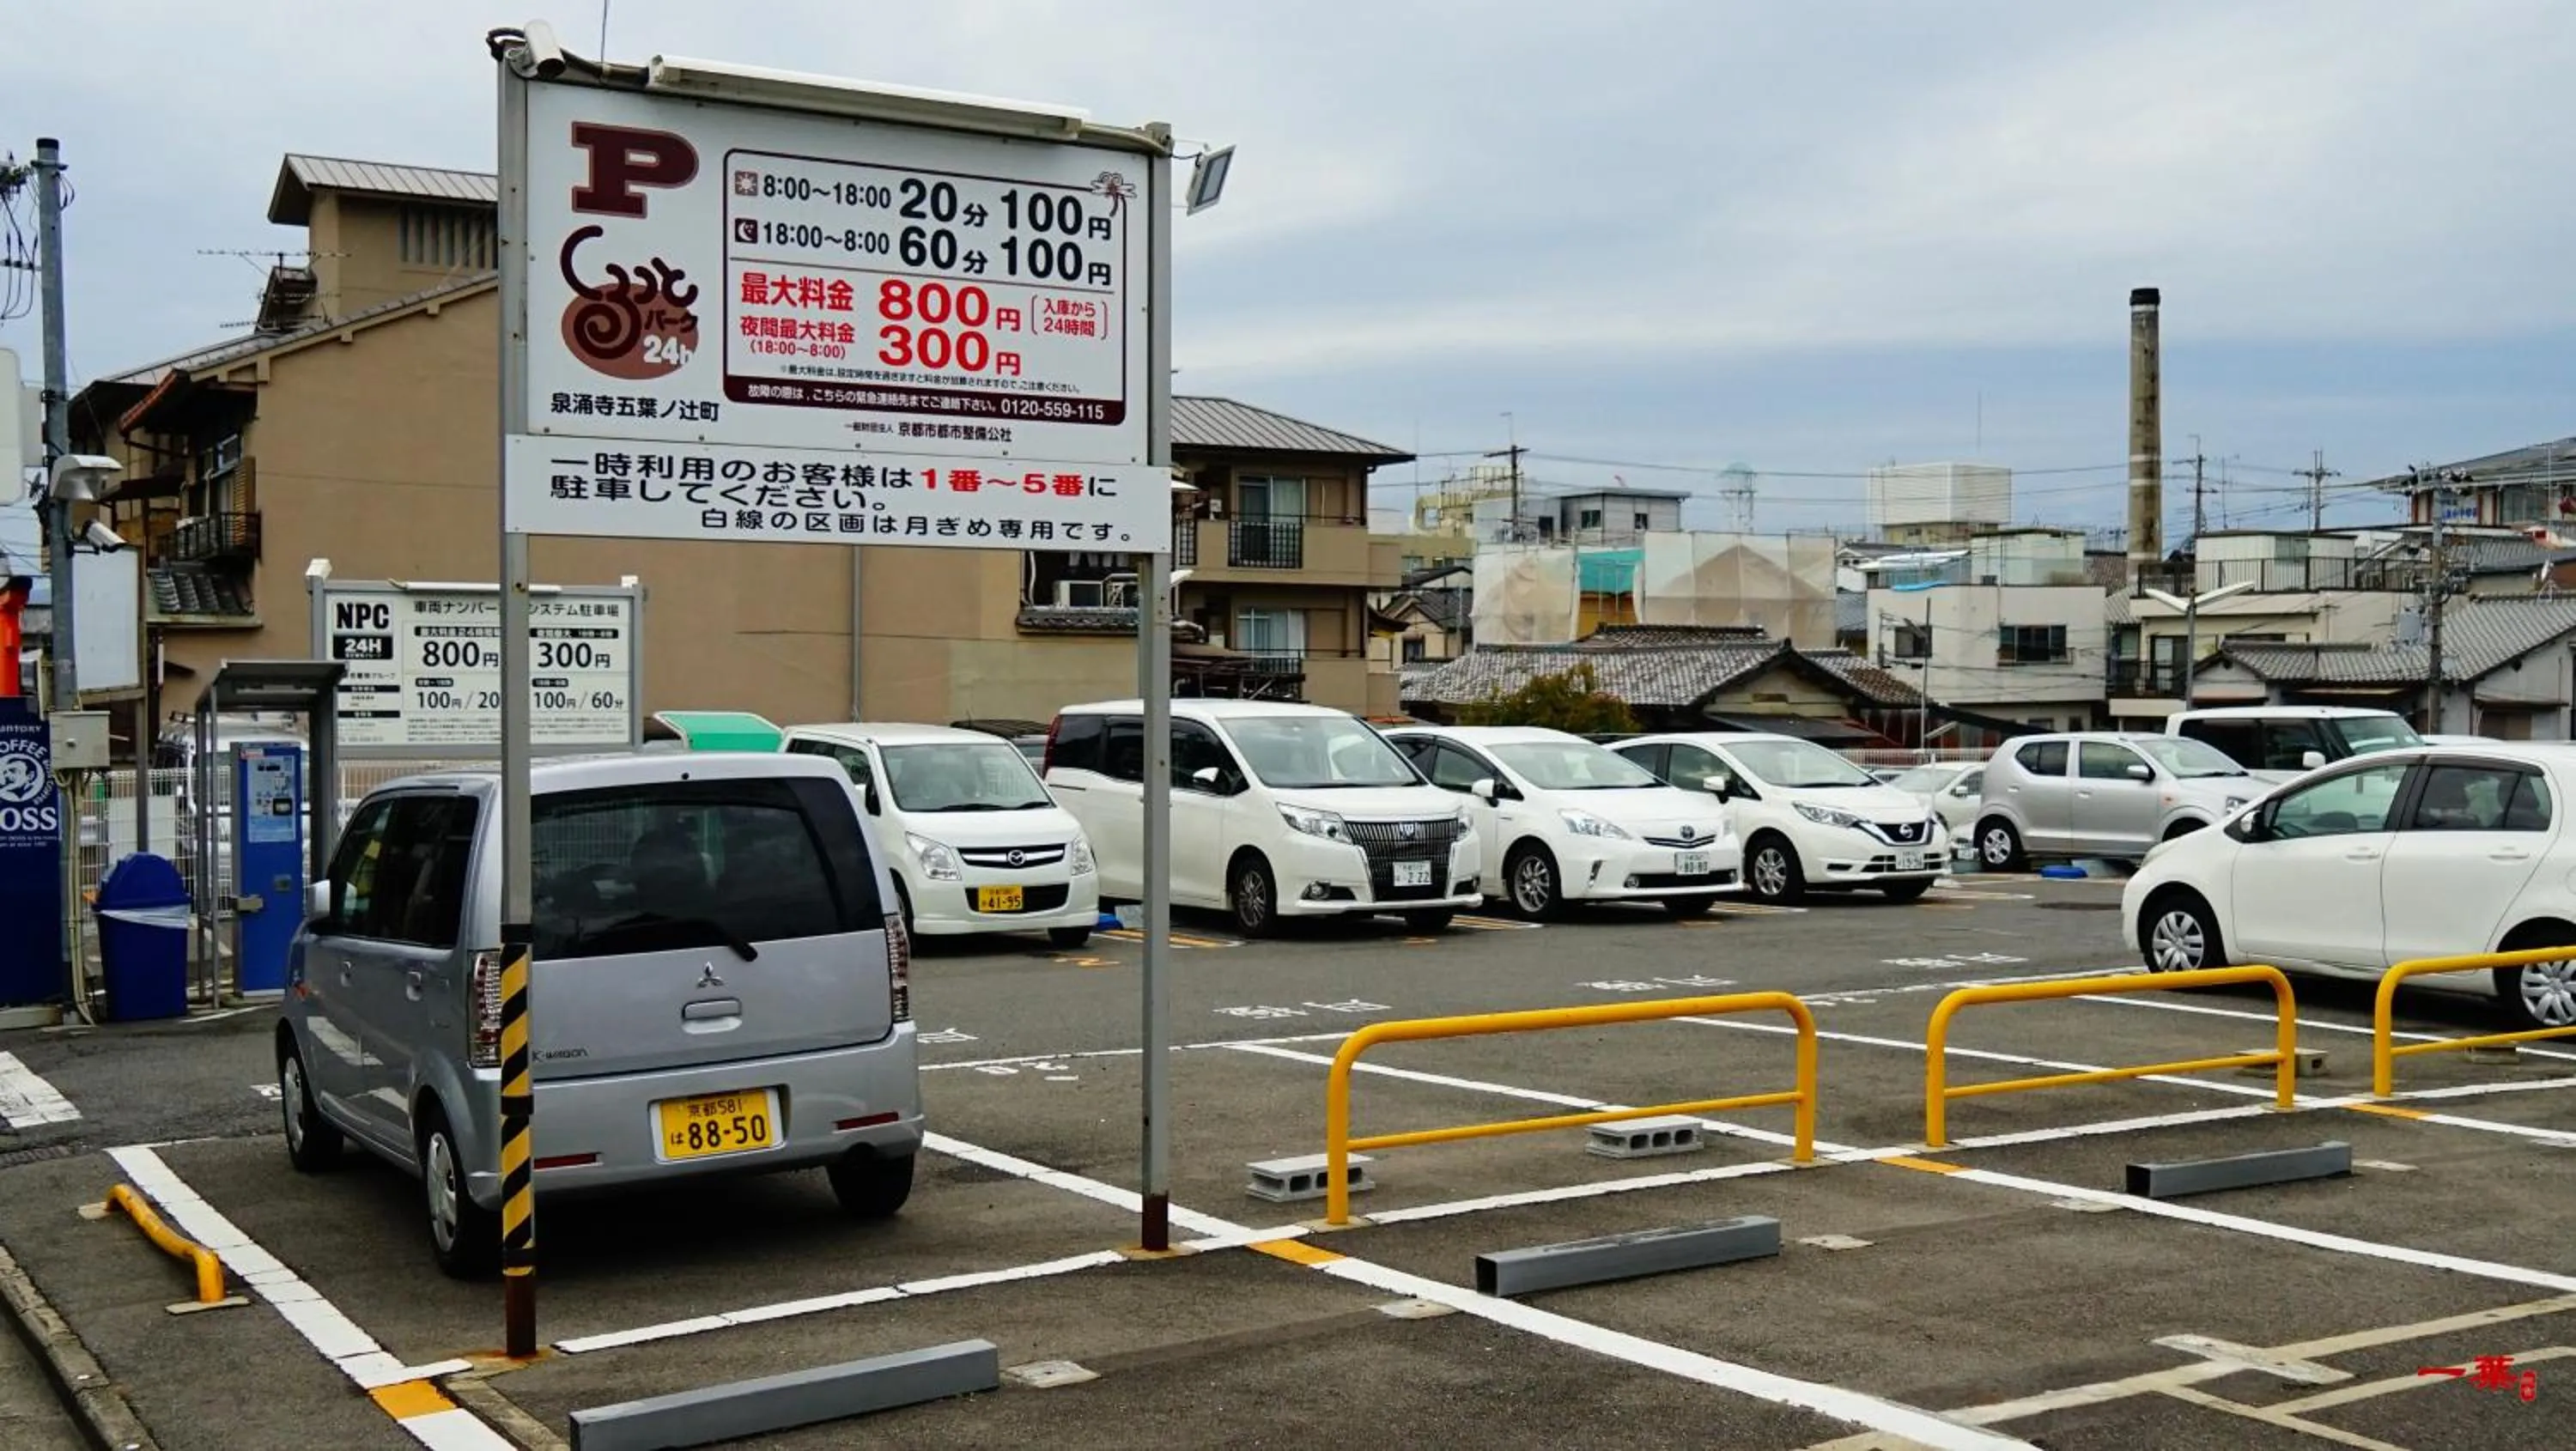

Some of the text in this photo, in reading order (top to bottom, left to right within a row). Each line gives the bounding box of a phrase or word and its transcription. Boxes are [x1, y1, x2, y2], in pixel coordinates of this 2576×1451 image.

[571, 120, 700, 219] P
[899, 178, 988, 228] 20分
[1000, 189, 1111, 240] 100円
[899, 226, 988, 275] 60分
[1000, 235, 1111, 286] 100円
[741, 272, 854, 311] 最大料金
[878, 279, 1021, 332] 800円
[740, 315, 855, 343] 夜間最大料金
[878, 325, 1021, 376] 300円
[1000, 398, 1104, 420] 0120-559-115
[550, 476, 885, 512] 駐車してください。
[702, 508, 1131, 543] 白線の区画は月ぎめ専用です。
[336, 602, 389, 629] NPC
[344, 638, 382, 653] 24H
[422, 641, 499, 667] 800円
[538, 642, 611, 668] 300円
[0, 739, 47, 759] OFFEE
[0, 806, 58, 831] OSS
[688, 1114, 766, 1150] 88-50
